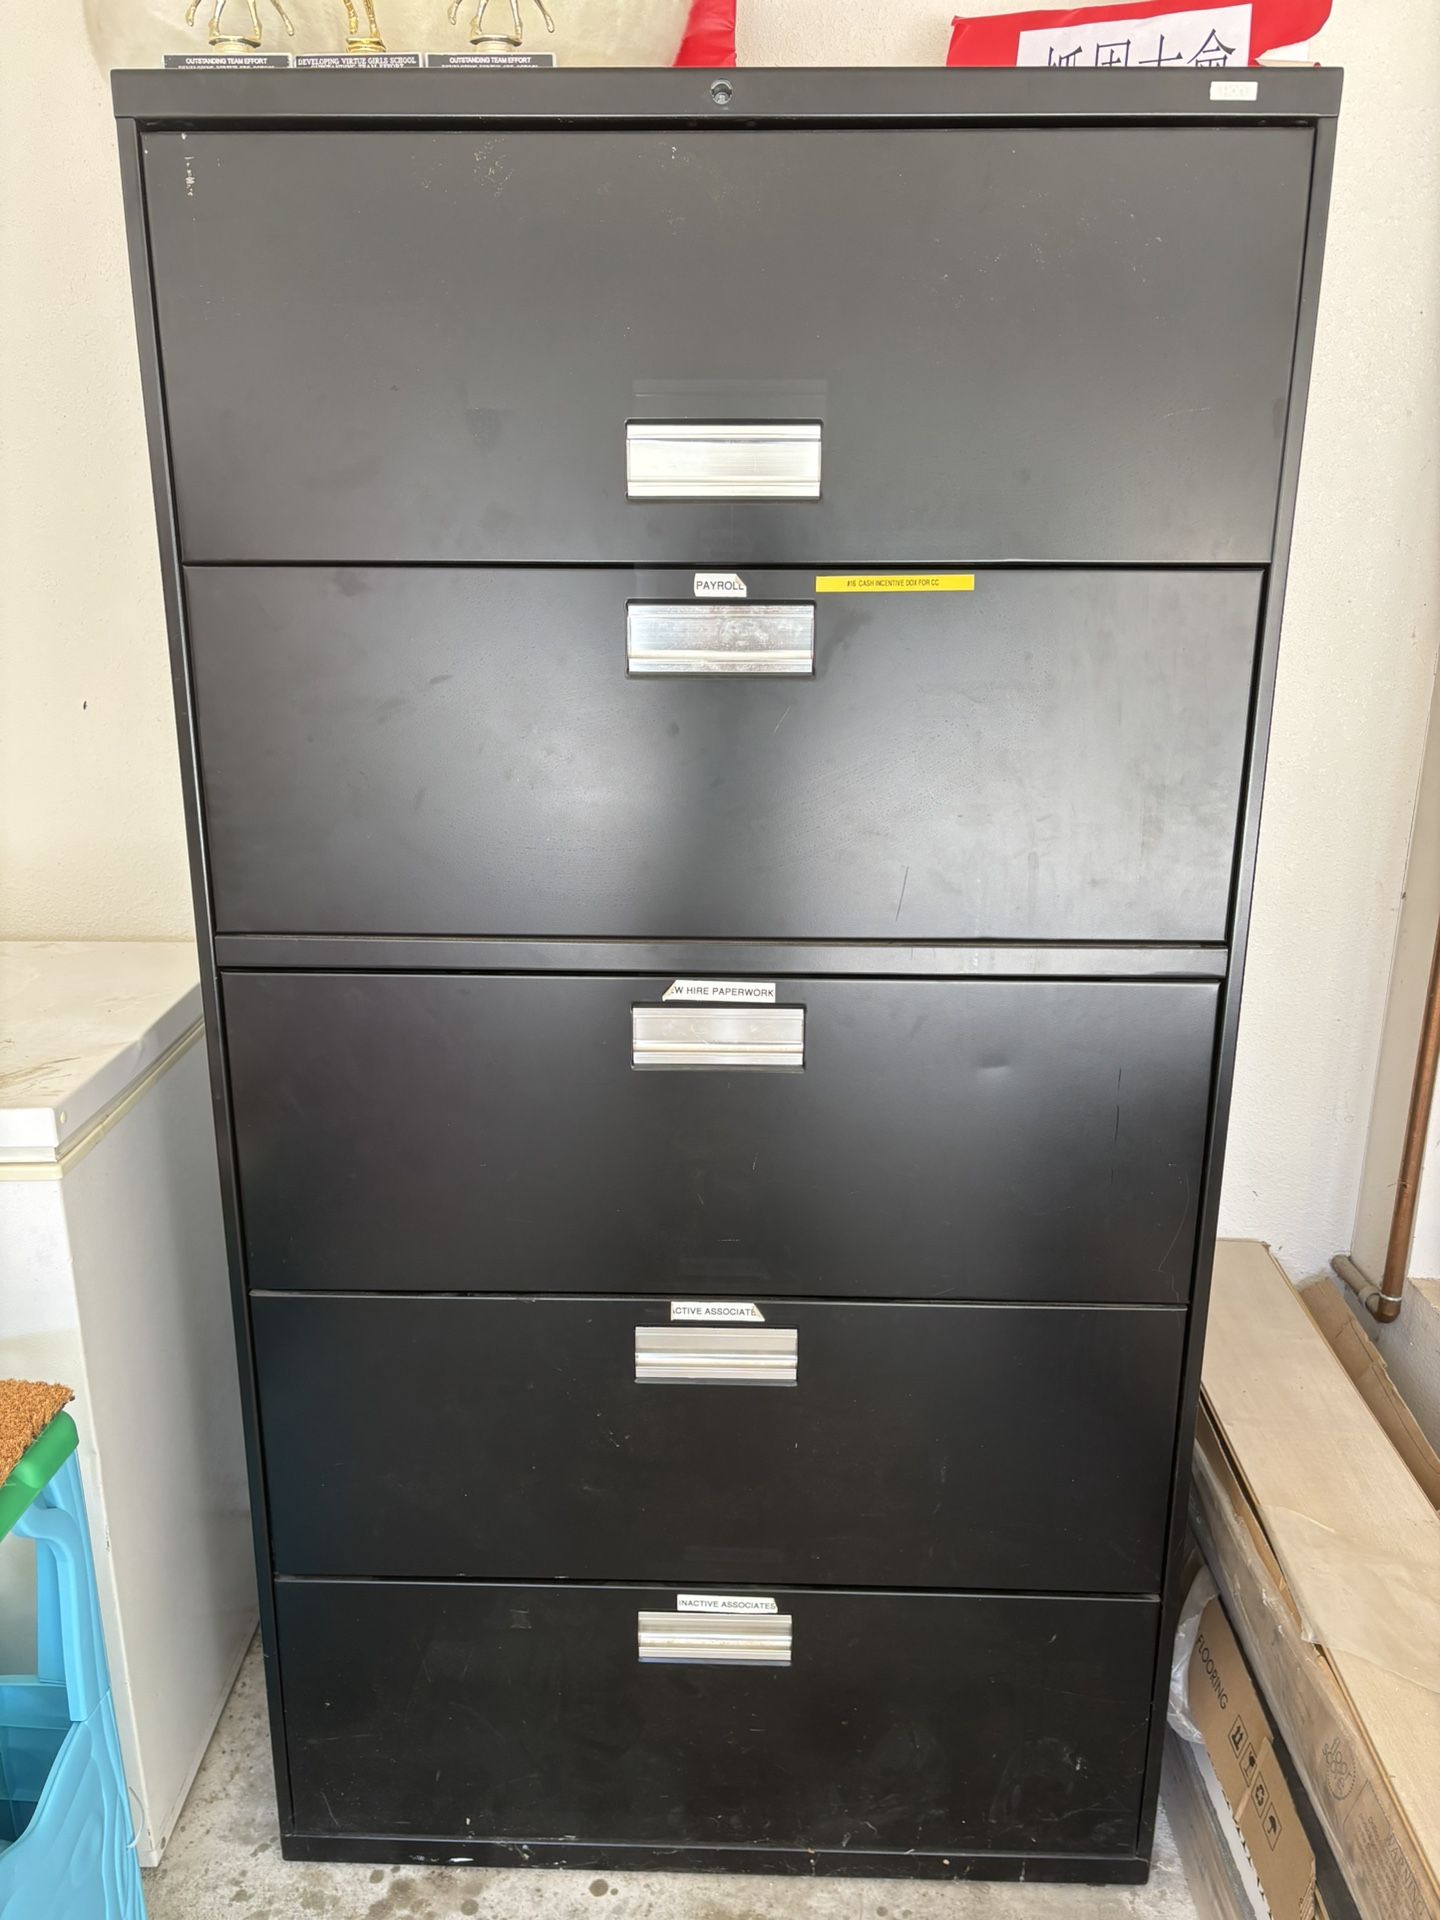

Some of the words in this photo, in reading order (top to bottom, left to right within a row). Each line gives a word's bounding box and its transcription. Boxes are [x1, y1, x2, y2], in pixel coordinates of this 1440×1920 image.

[185, 57, 227, 65] OUTSTANDING
[227, 57, 244, 65] TEAM
[244, 57, 268, 65] EFFORT
[297, 58, 340, 66] DEVELOPING
[341, 57, 367, 65] VIRTUE
[389, 56, 417, 64] SCHOOL
[491, 56, 508, 64] TEAM
[508, 56, 532, 64] EFFORT
[696, 580, 745, 591] PAYROLL
[858, 579, 875, 588] CASH
[919, 578, 930, 587] FOR
[686, 986, 710, 996] HIRE
[712, 987, 775, 997] PAPERWORK
[678, 1599, 719, 1608] INACTIVE
[721, 1601, 776, 1610] ASSOCIATES
[1196, 1634, 1229, 1710] FLOORING
